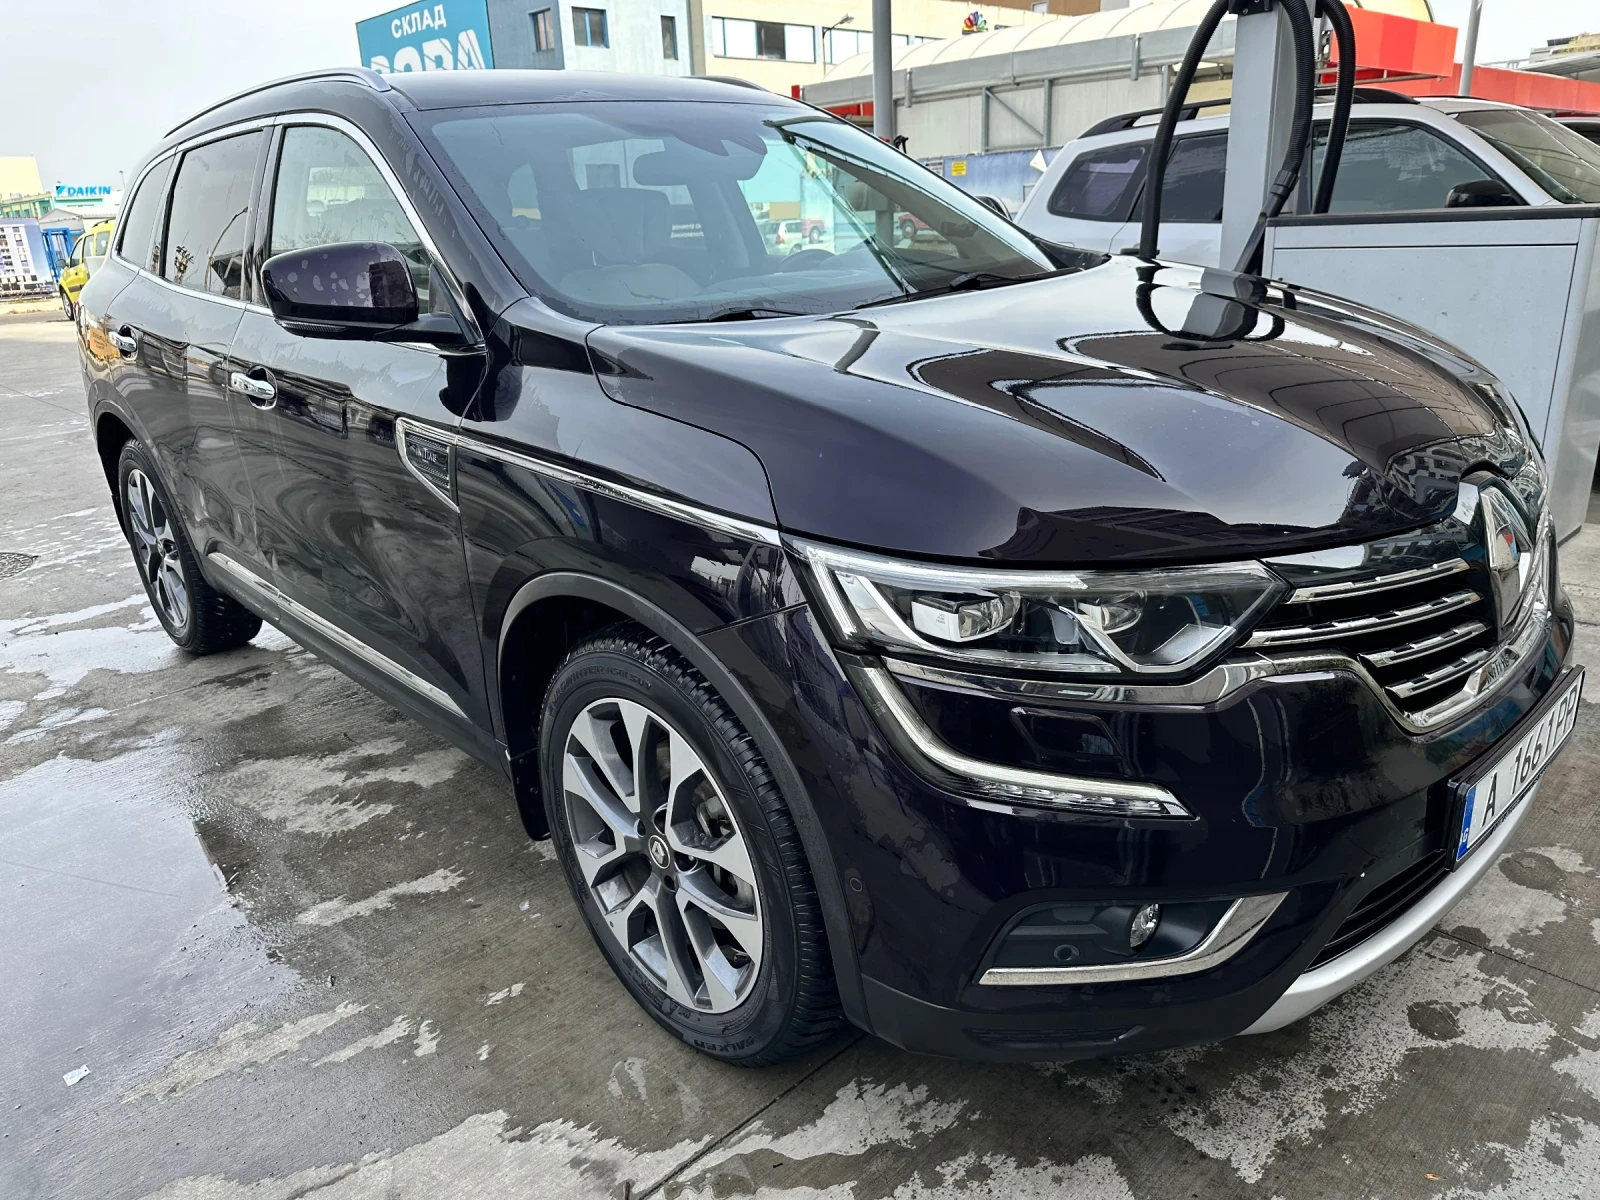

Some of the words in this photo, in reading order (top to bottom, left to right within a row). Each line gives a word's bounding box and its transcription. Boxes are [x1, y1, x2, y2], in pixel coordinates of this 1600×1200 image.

[391, 4, 447, 39] СКЛАД
[67, 185, 111, 196] DAIKIN
[629, 673, 653, 691] SUV
[1481, 771, 1497, 827] A
[693, 1035, 756, 1052] FALKEN
